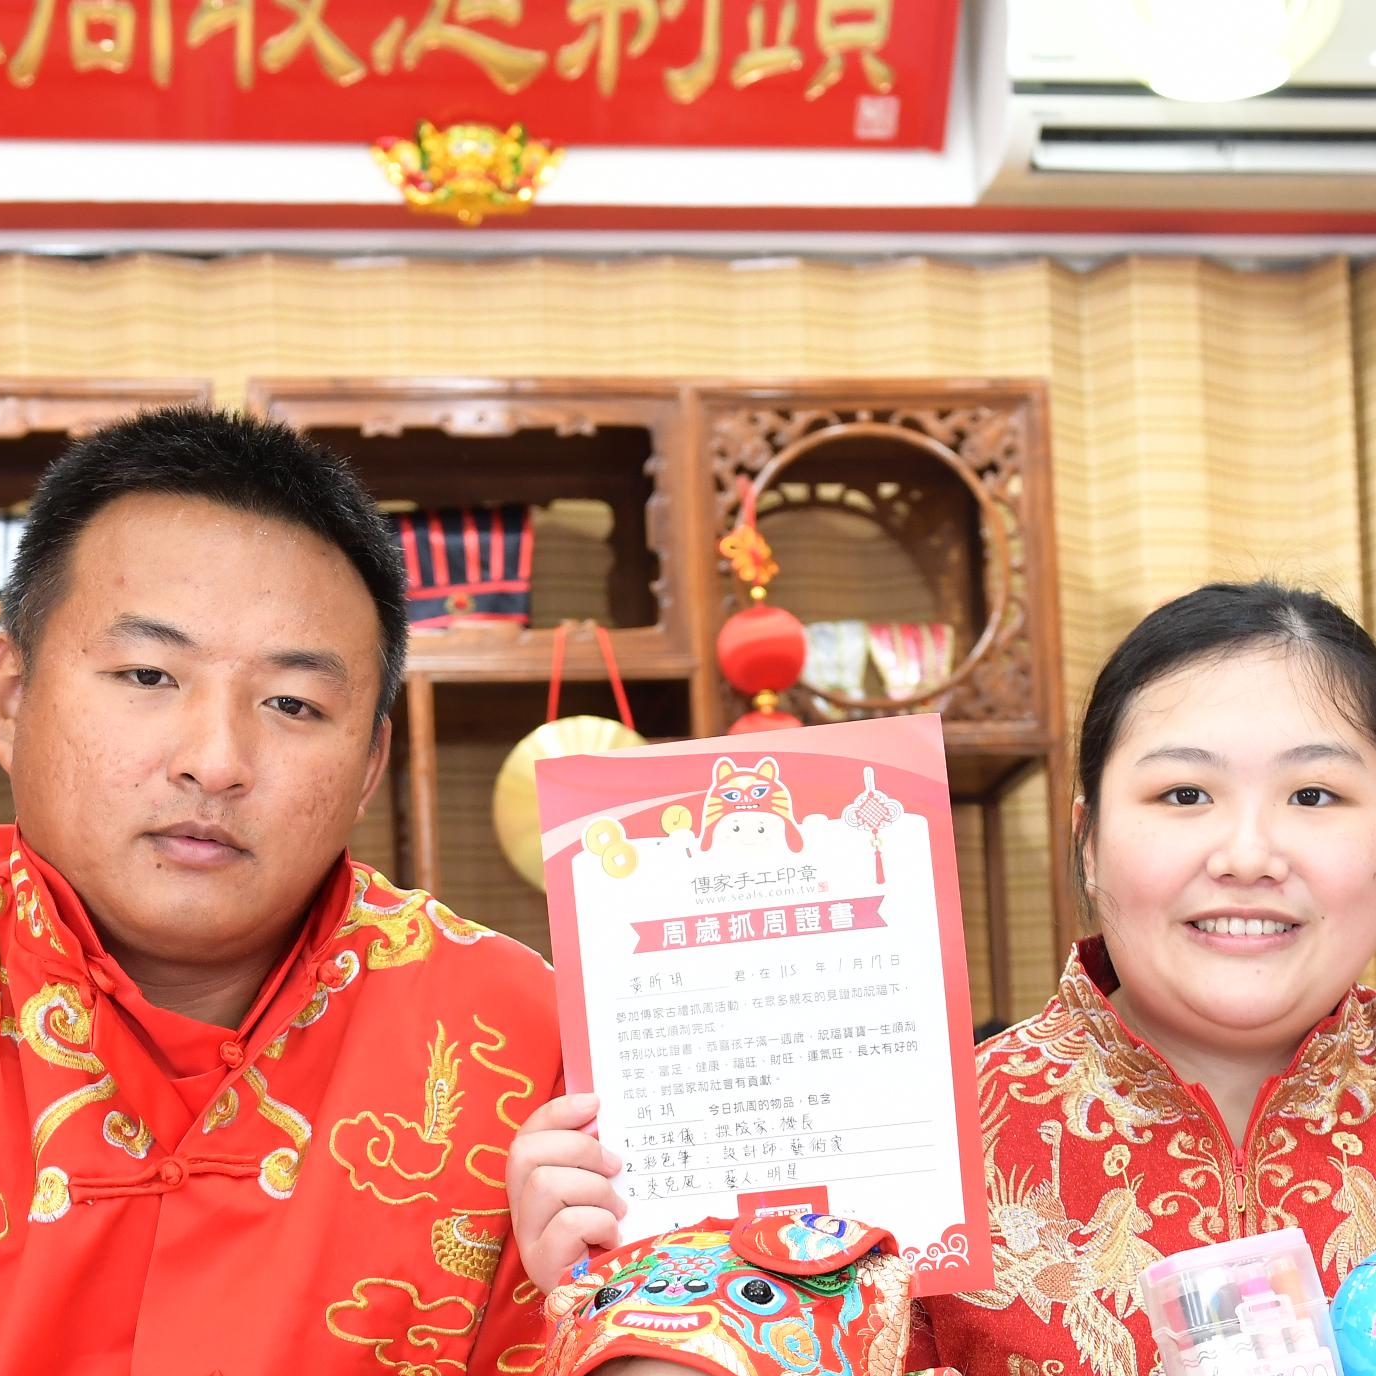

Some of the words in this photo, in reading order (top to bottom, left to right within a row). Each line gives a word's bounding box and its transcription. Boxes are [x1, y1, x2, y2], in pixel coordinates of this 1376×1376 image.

[690, 864, 817, 894] 傳家手工印章
[694, 885, 816, 905] www.seals.com.tw
[661, 902, 856, 948] 周歲抓周證書
[815, 962, 826, 973] 年
[853, 958, 863, 970] 月
[890, 954, 900, 966] 日
